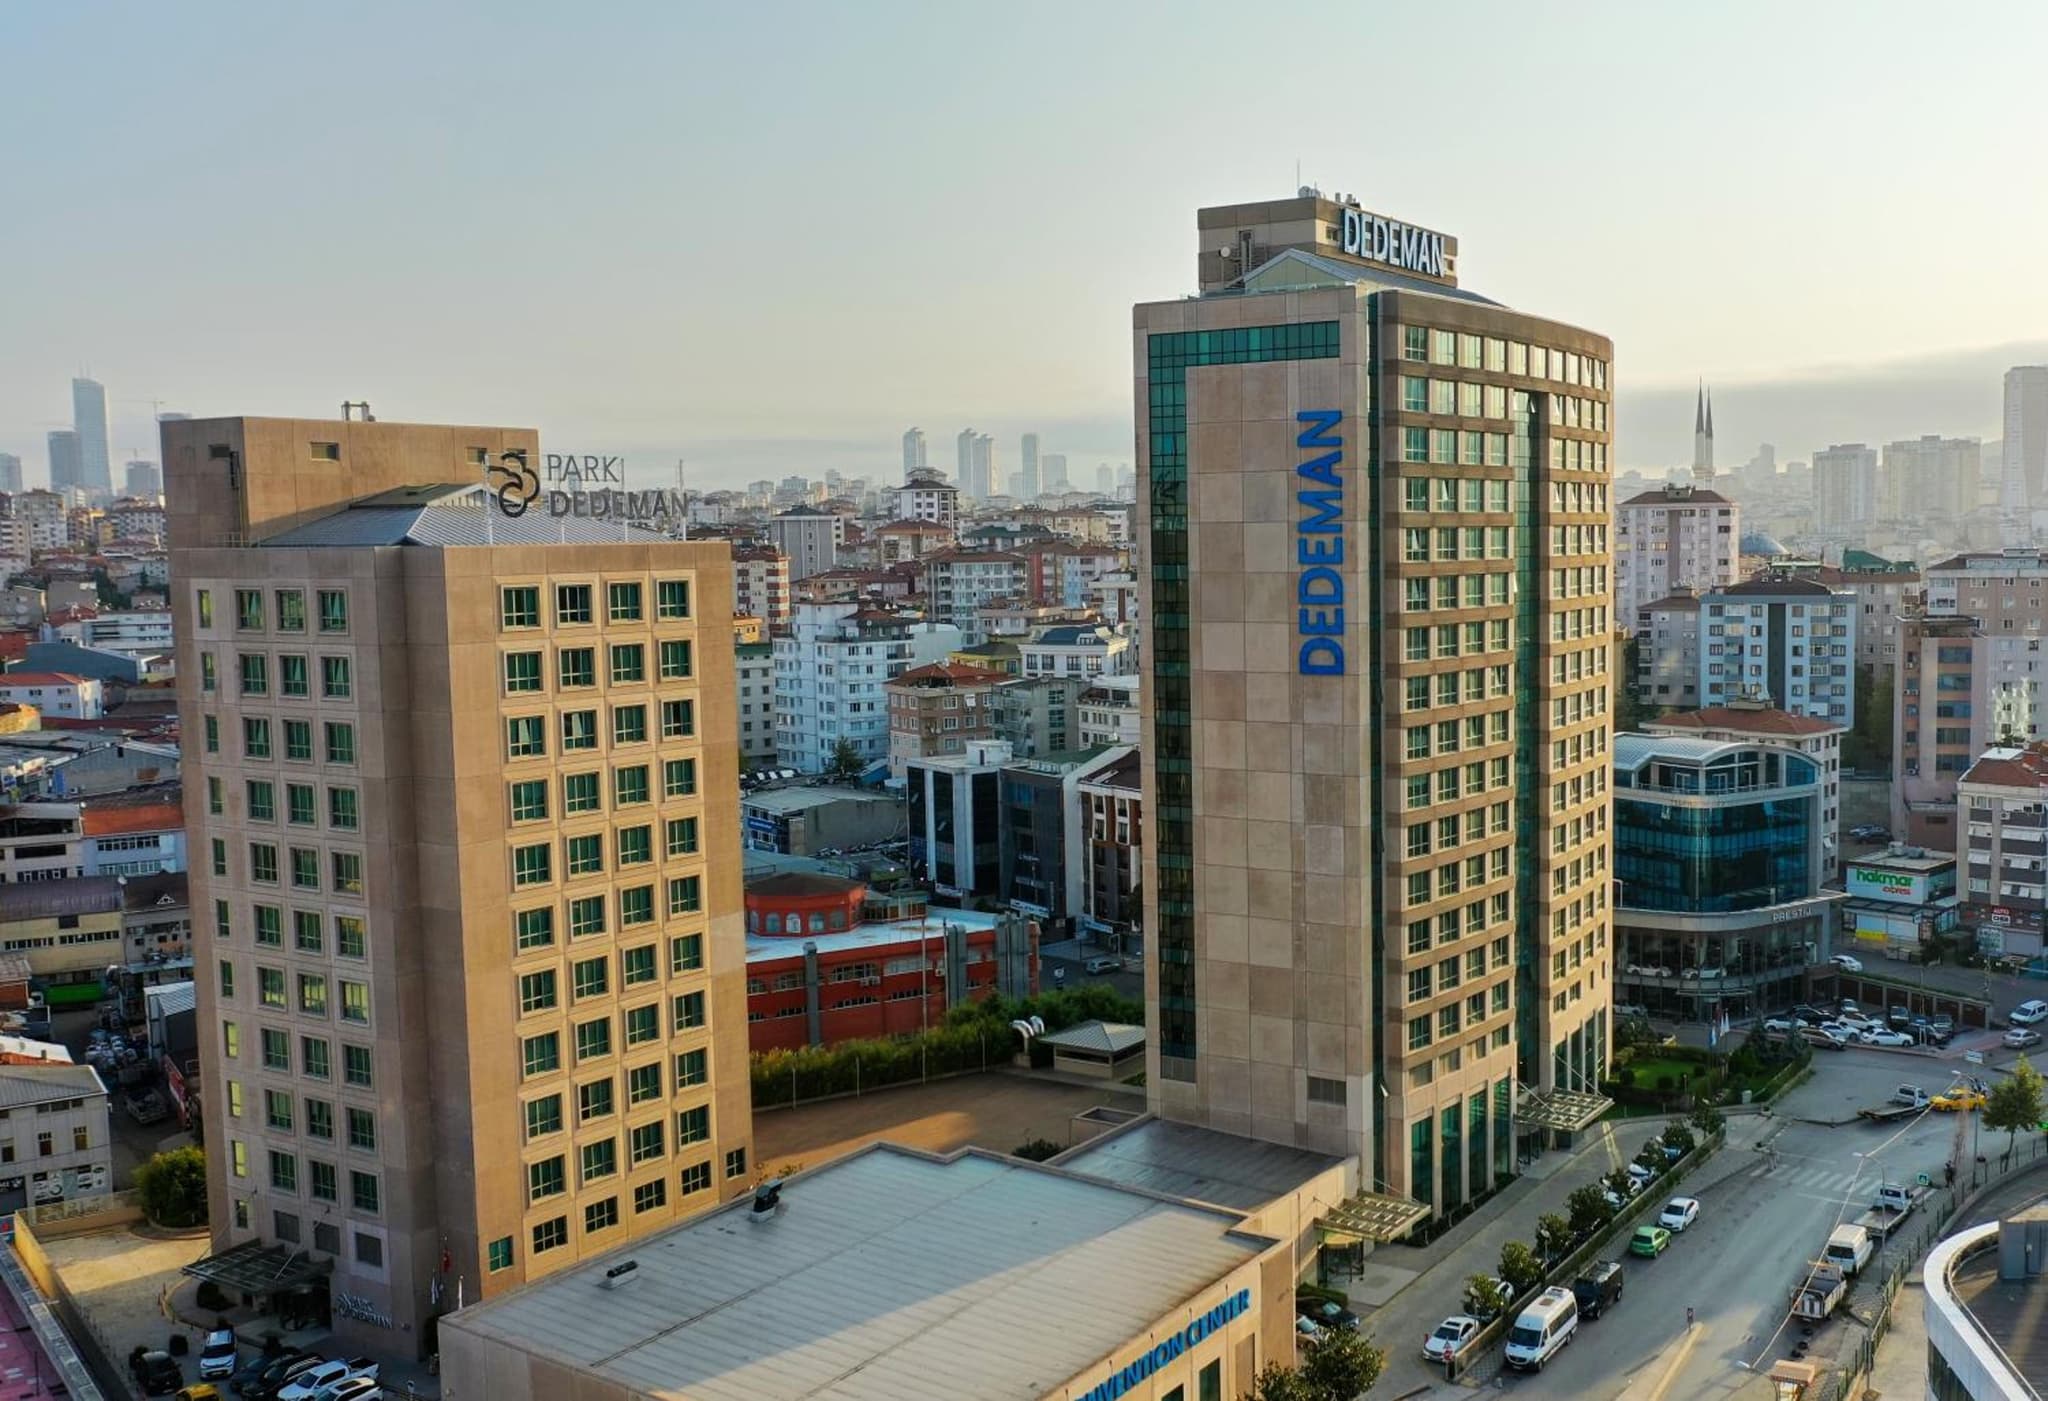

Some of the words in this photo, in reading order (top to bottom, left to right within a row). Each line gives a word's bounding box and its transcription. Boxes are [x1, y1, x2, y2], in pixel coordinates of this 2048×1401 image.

[1343, 207, 1445, 278] DEDEMAN
[547, 454, 619, 482] PARK
[549, 490, 688, 519] DEDEMAN
[1297, 410, 1344, 676] DEDEMAN
[1856, 867, 1913, 887] hakmar
[1186, 1288, 1250, 1348] CENTER
